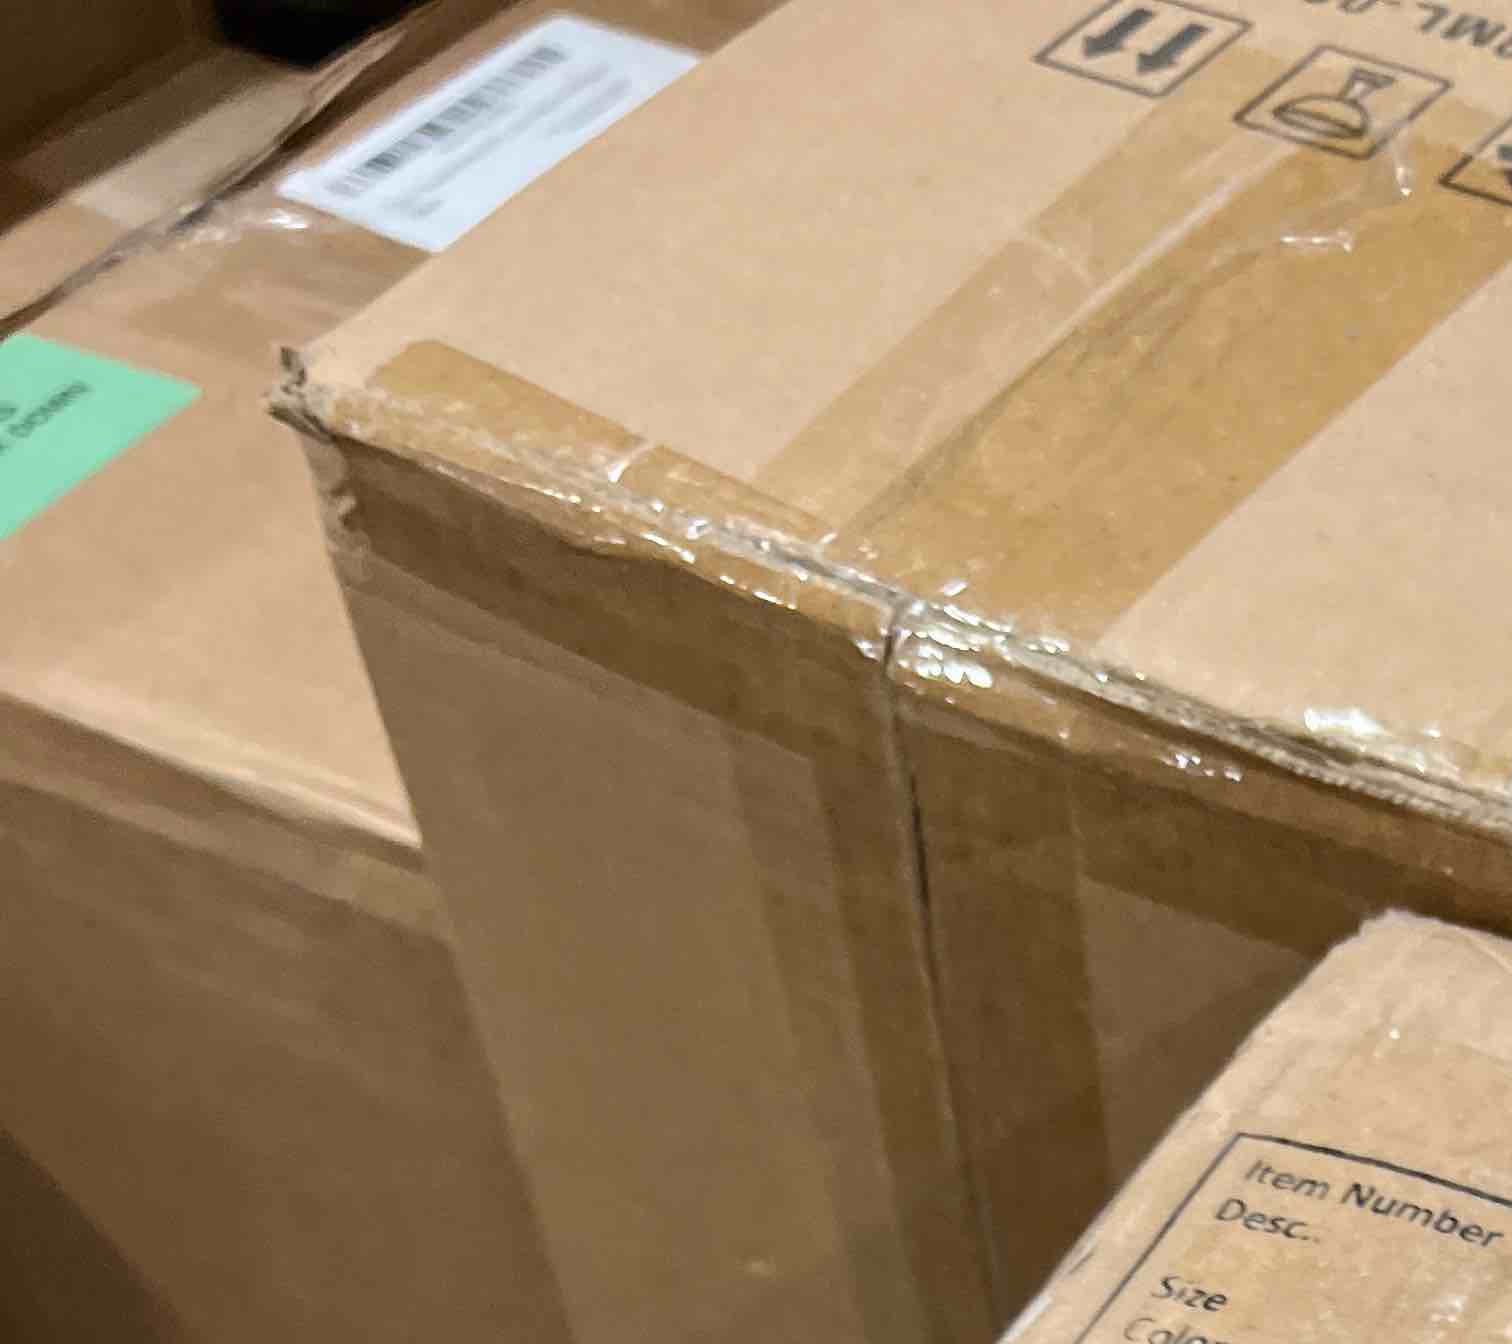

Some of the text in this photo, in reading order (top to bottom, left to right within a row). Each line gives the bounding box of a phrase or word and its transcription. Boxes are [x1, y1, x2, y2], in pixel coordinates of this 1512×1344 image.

[1244, 1157, 1330, 1201] Item
[1340, 1181, 1505, 1250] Number
[1150, 1271, 1230, 1314] Size
